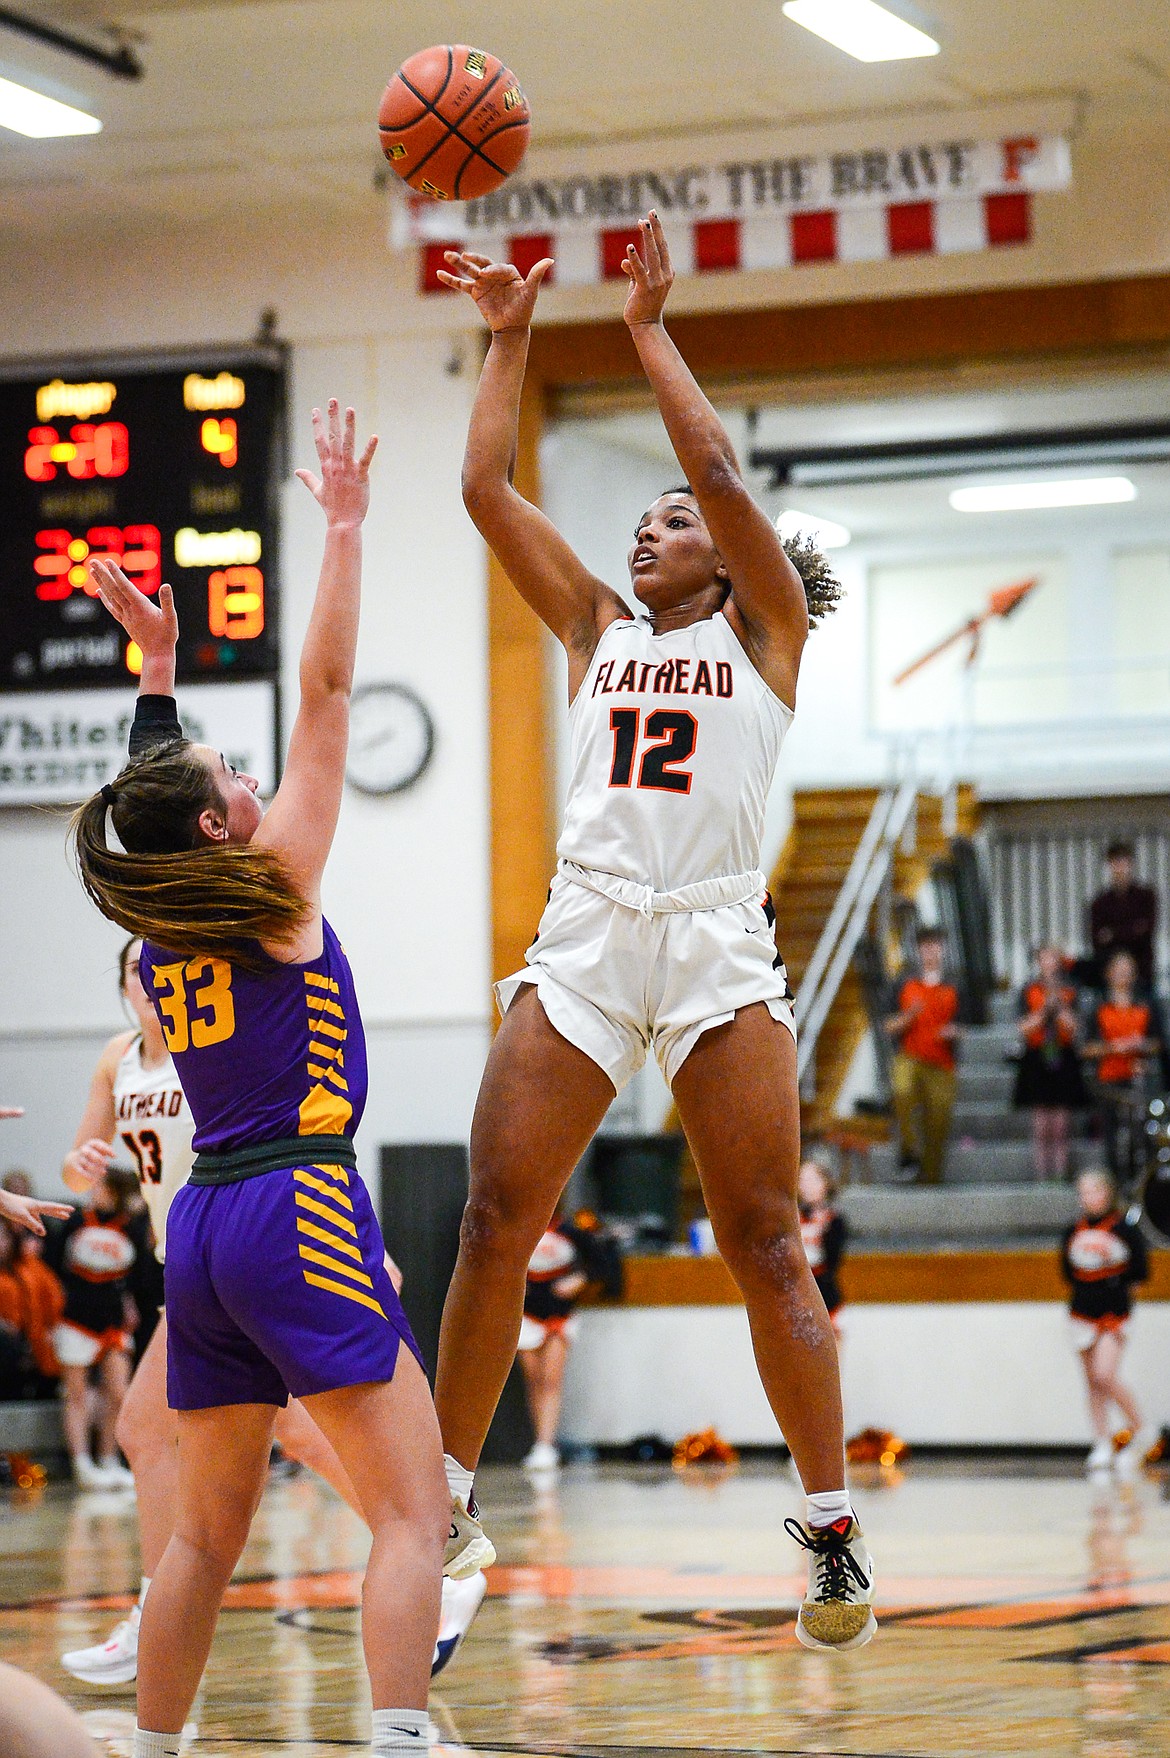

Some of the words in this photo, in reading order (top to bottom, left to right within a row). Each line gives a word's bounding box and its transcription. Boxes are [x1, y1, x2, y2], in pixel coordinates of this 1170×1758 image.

[467, 155, 713, 228] HONORING
[722, 156, 813, 208] THE
[830, 139, 978, 198] BRAVE
[590, 658, 734, 699] FLATHEAD
[608, 707, 698, 795] 12
[151, 956, 235, 1053] 33
[121, 1129, 162, 1185] 13
